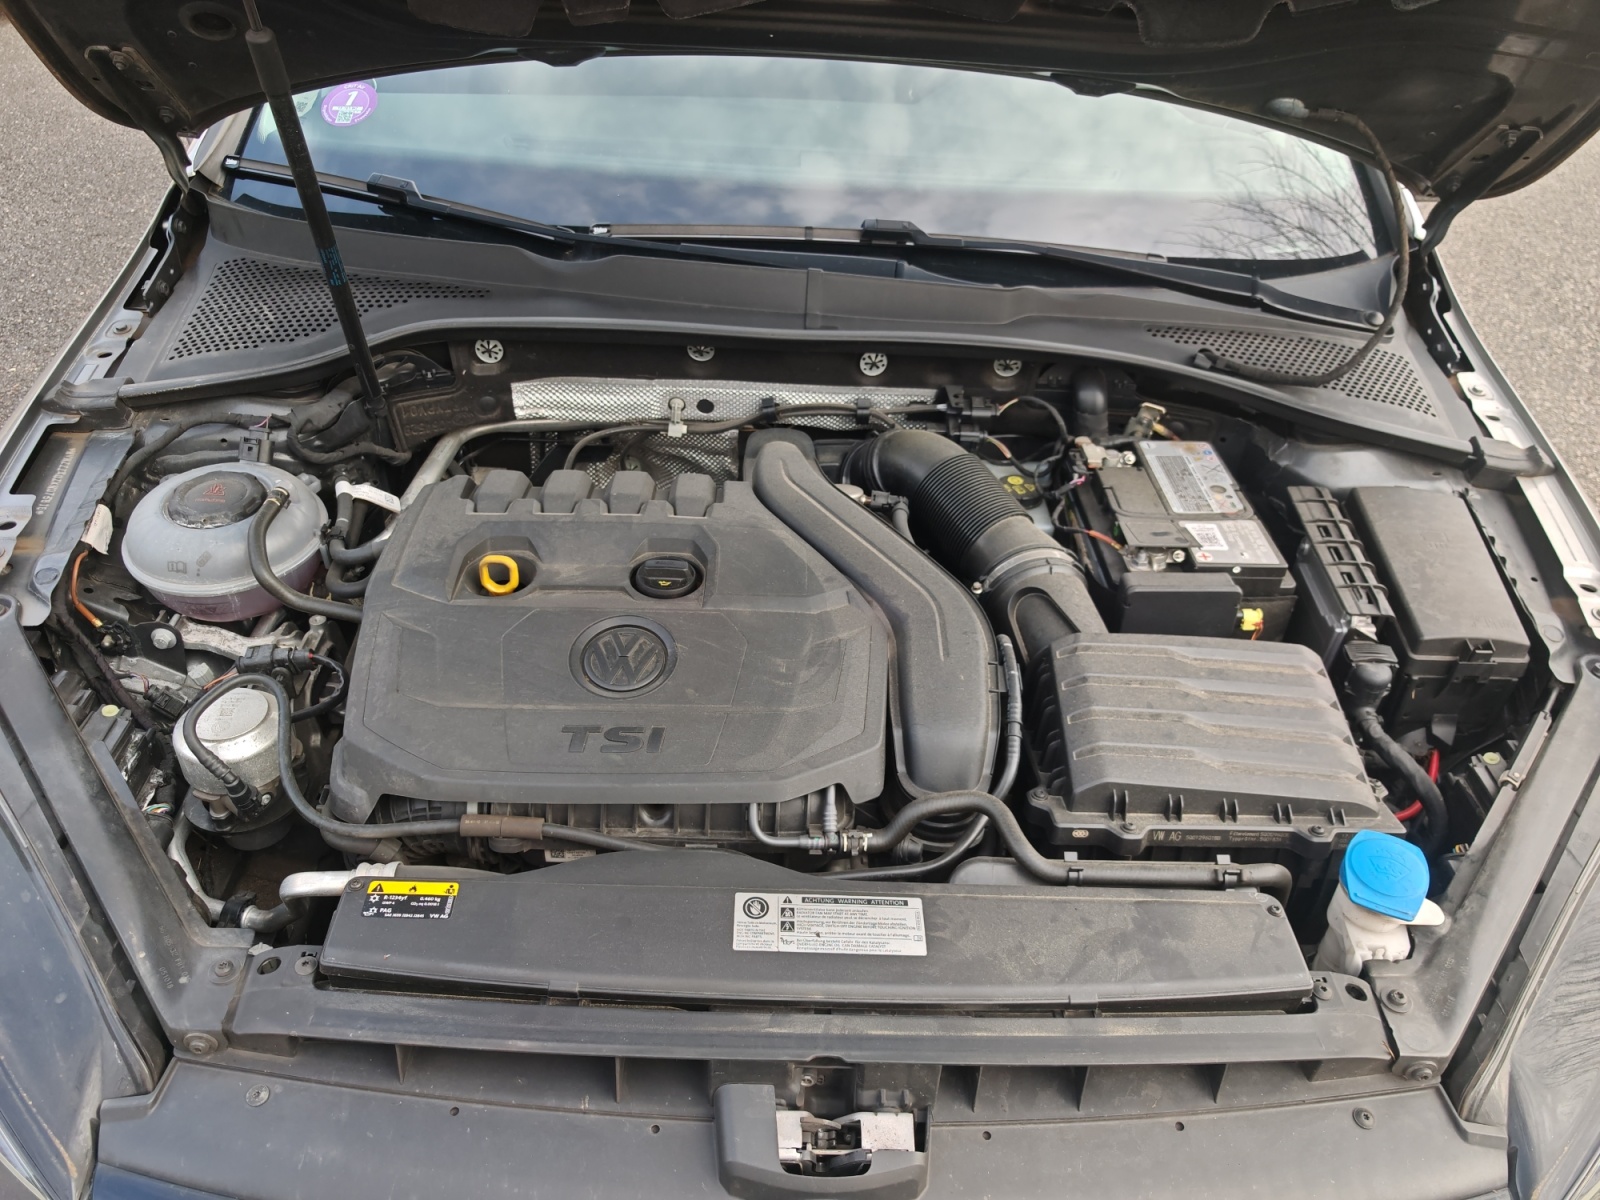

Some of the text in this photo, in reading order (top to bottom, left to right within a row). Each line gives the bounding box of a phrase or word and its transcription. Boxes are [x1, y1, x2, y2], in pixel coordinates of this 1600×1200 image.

[346, 91, 358, 106] 1
[562, 725, 666, 753] TSI
[1153, 831, 1164, 841] VW
[1168, 831, 1182, 841] AG
